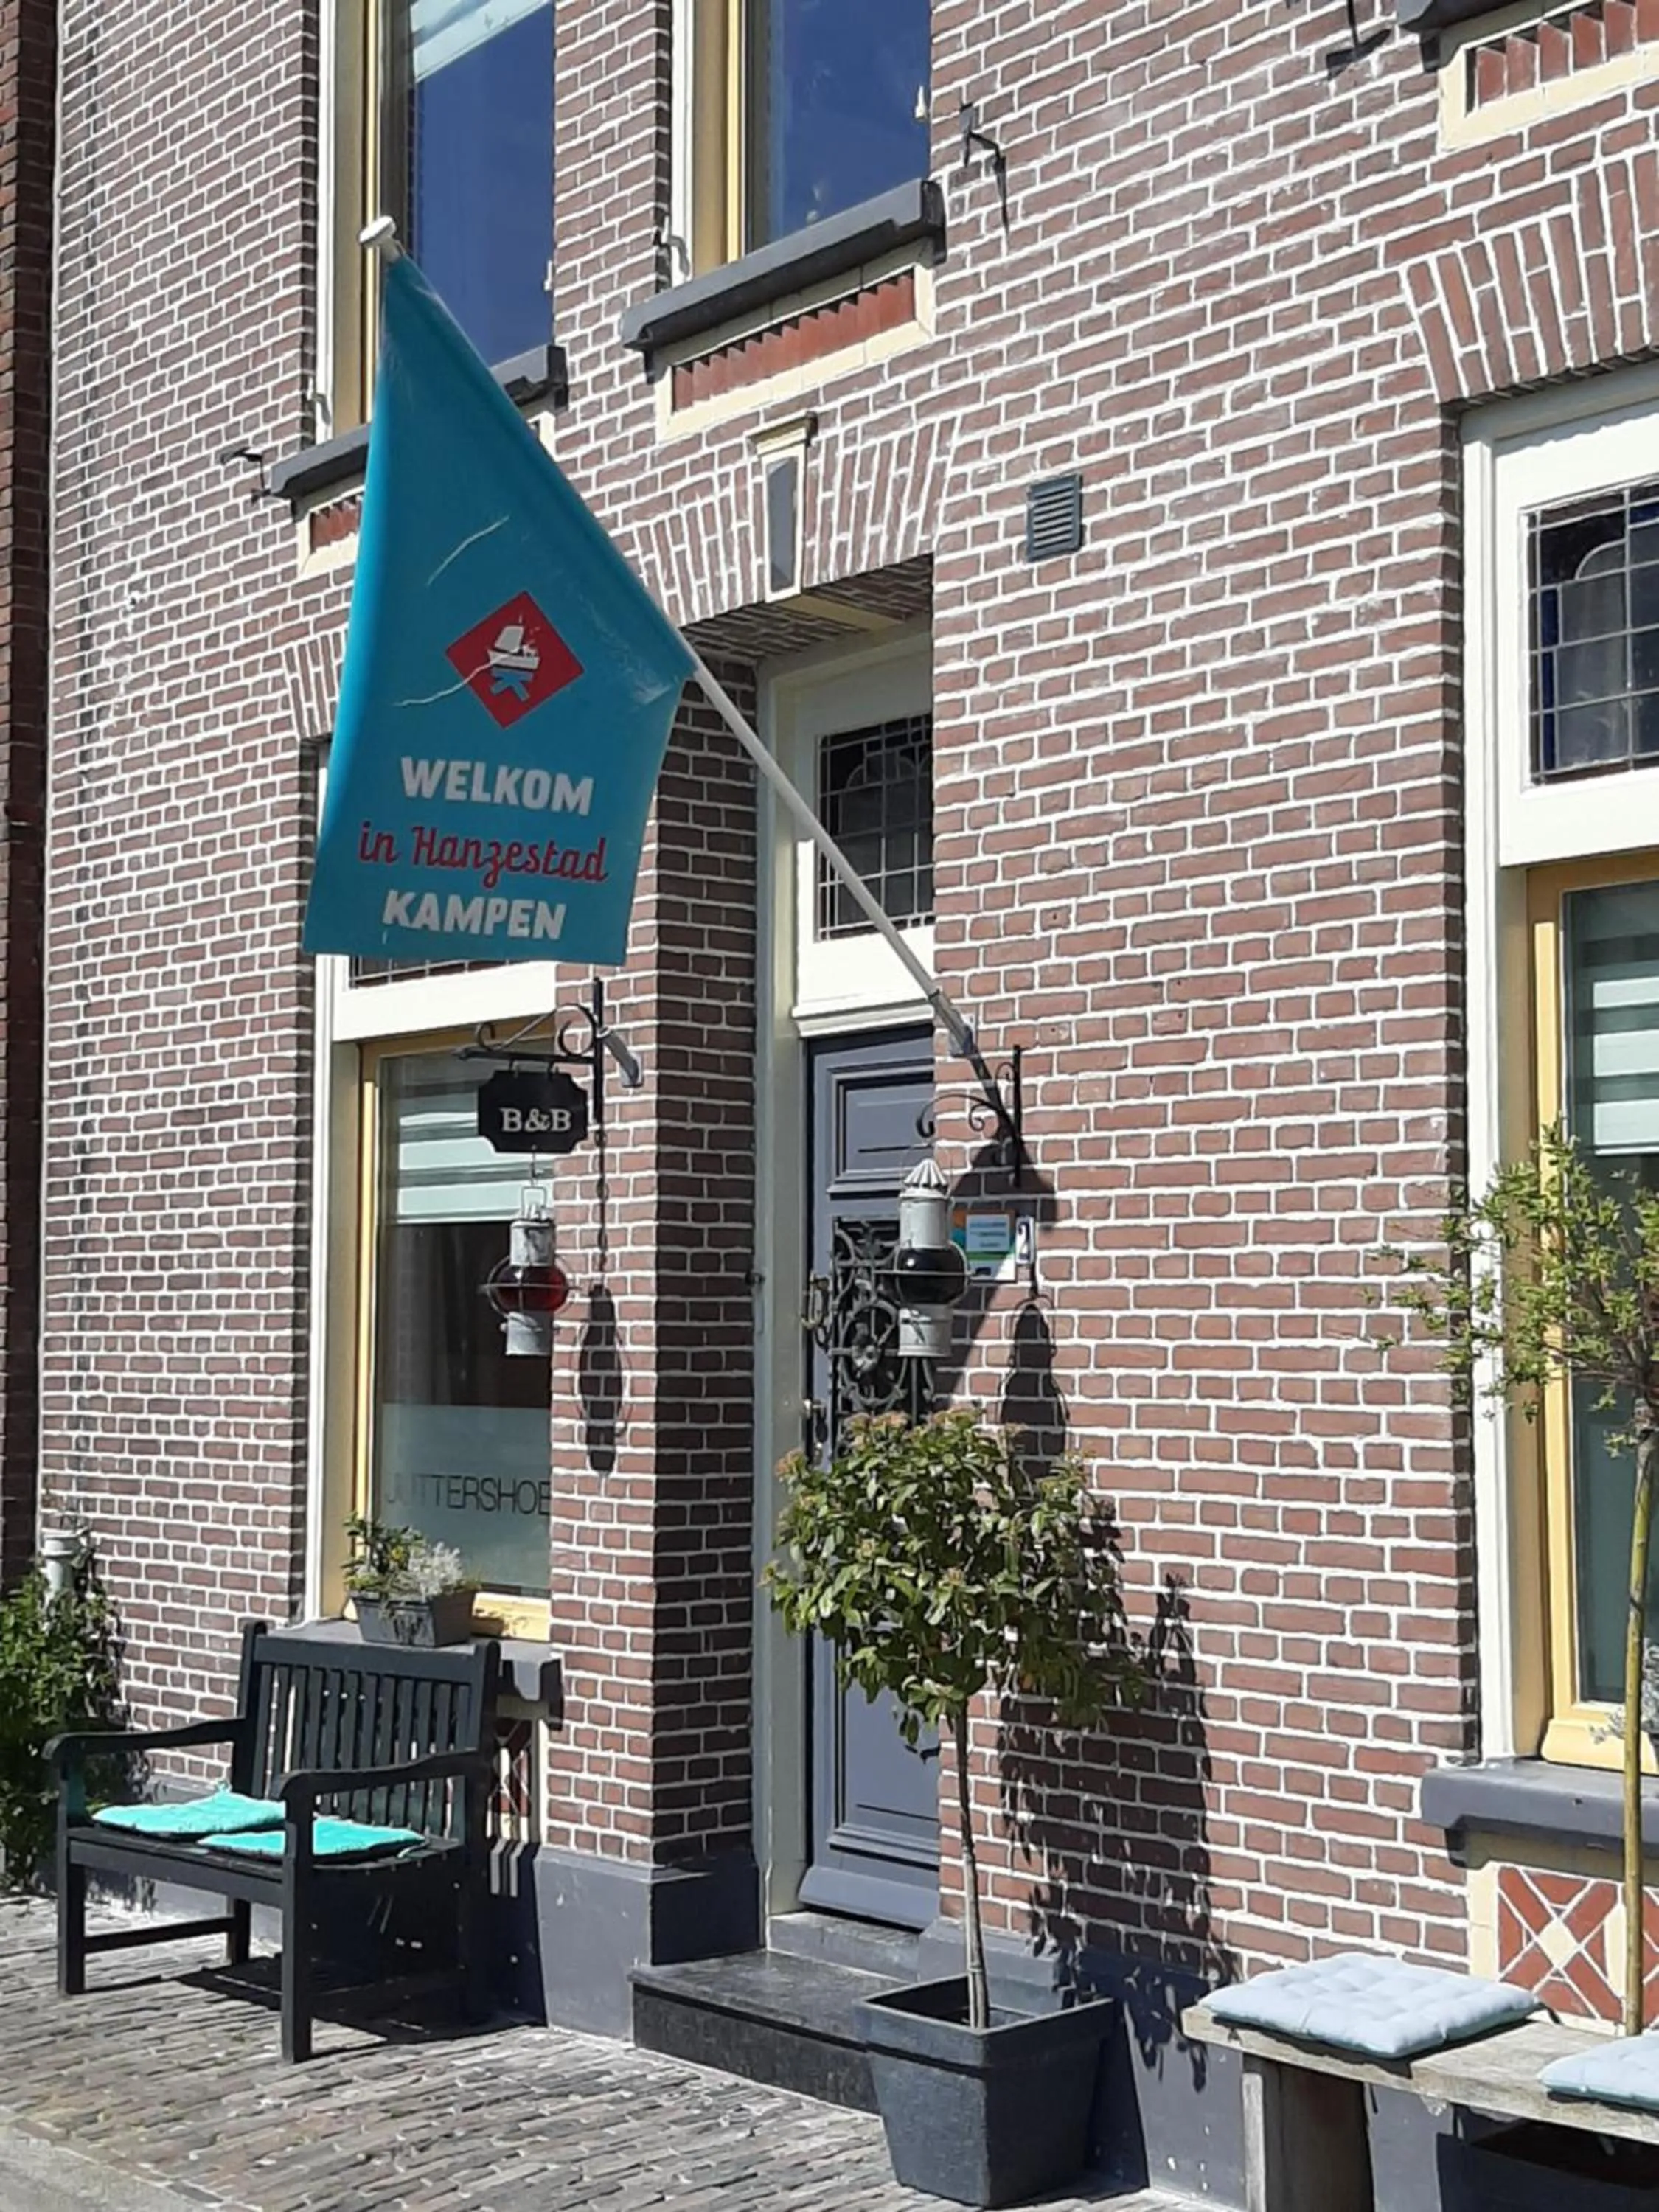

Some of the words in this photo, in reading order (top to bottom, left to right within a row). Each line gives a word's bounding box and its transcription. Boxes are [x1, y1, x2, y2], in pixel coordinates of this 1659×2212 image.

[400, 757, 594, 815] WELKOM
[358, 821, 401, 864] in
[411, 826, 609, 888] Hanzestad
[382, 890, 566, 940] KAMPEN
[500, 1107, 571, 1132] B&B
[1018, 1221, 1031, 1260] 2
